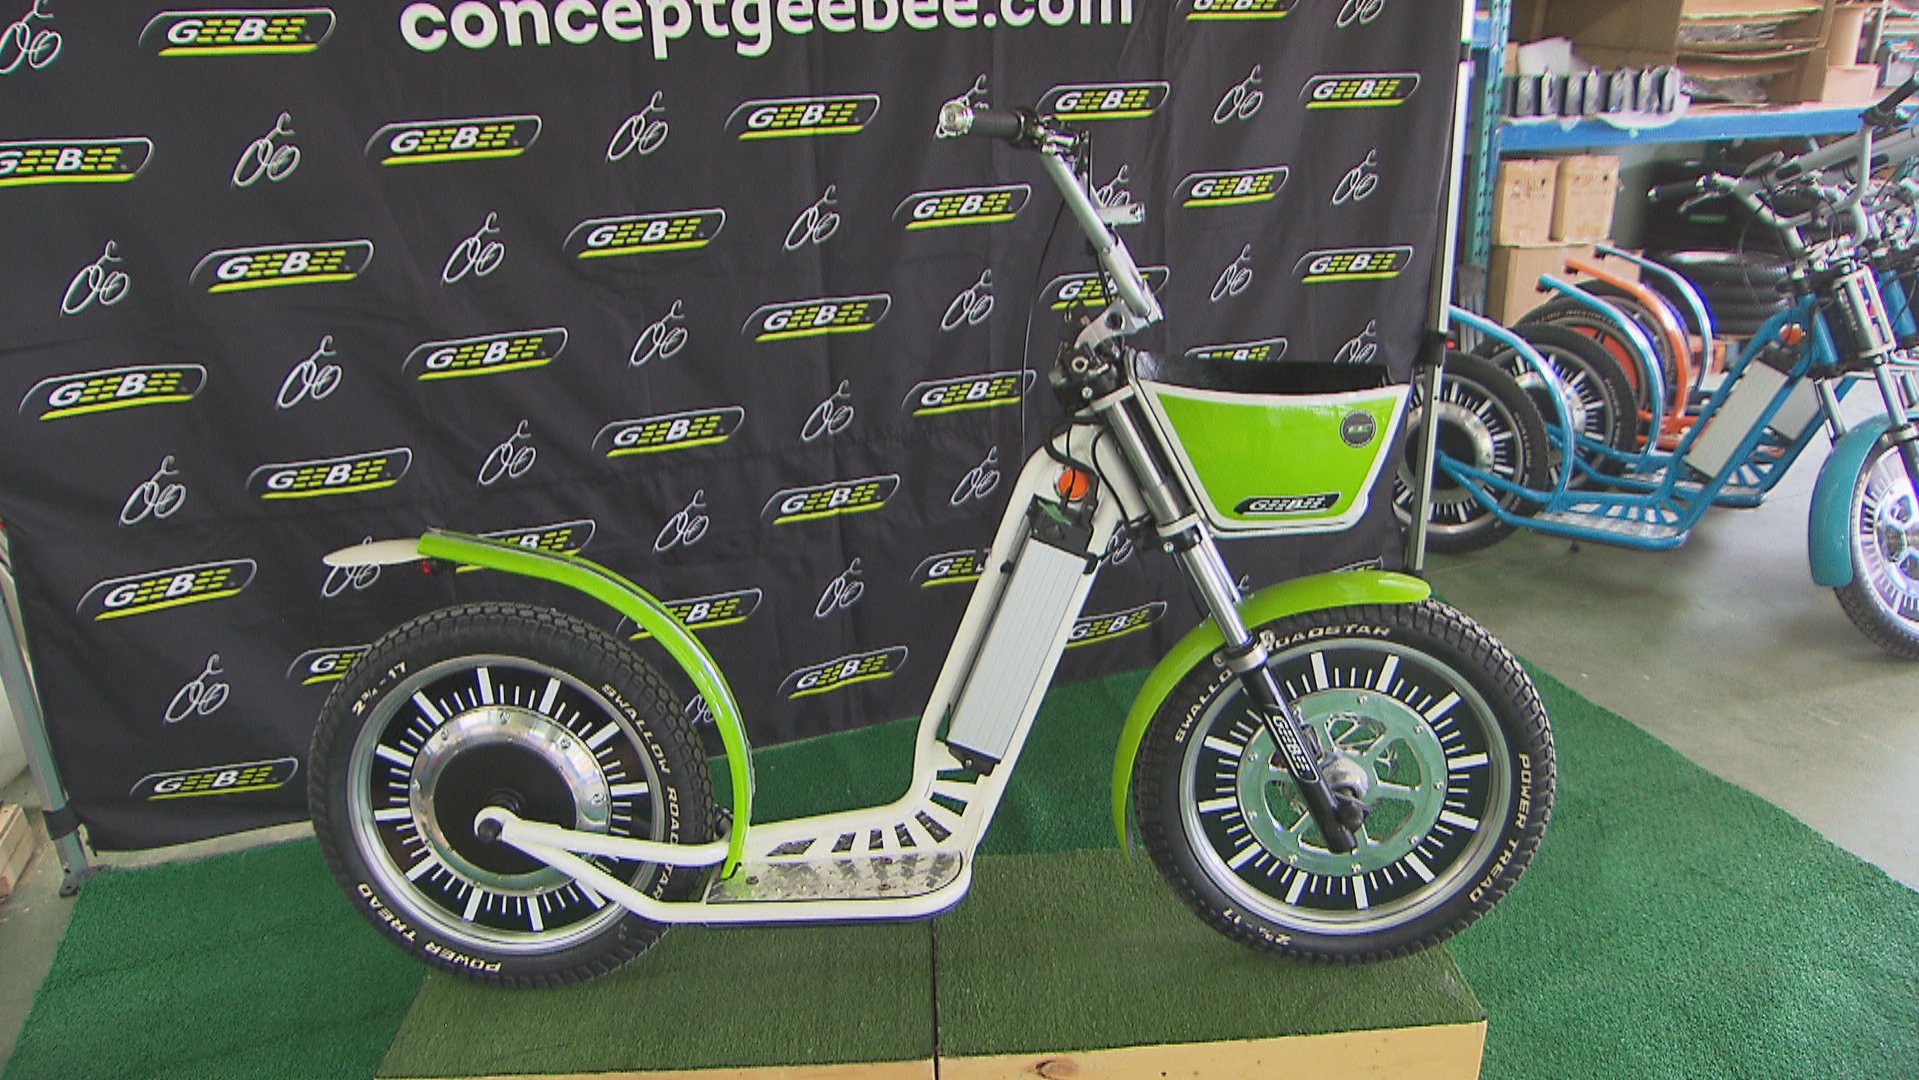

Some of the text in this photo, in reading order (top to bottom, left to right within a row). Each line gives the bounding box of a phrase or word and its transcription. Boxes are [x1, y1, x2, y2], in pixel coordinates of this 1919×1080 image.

[400, 0, 1133, 60] conceptgeebee.com
[1175, 623, 1391, 744] SWALLO OADSTAR
[601, 683, 680, 900] SWALLOW ROADTAR
[1469, 752, 1532, 903] POWER TREAD
[357, 883, 501, 973] POWER TREAD
